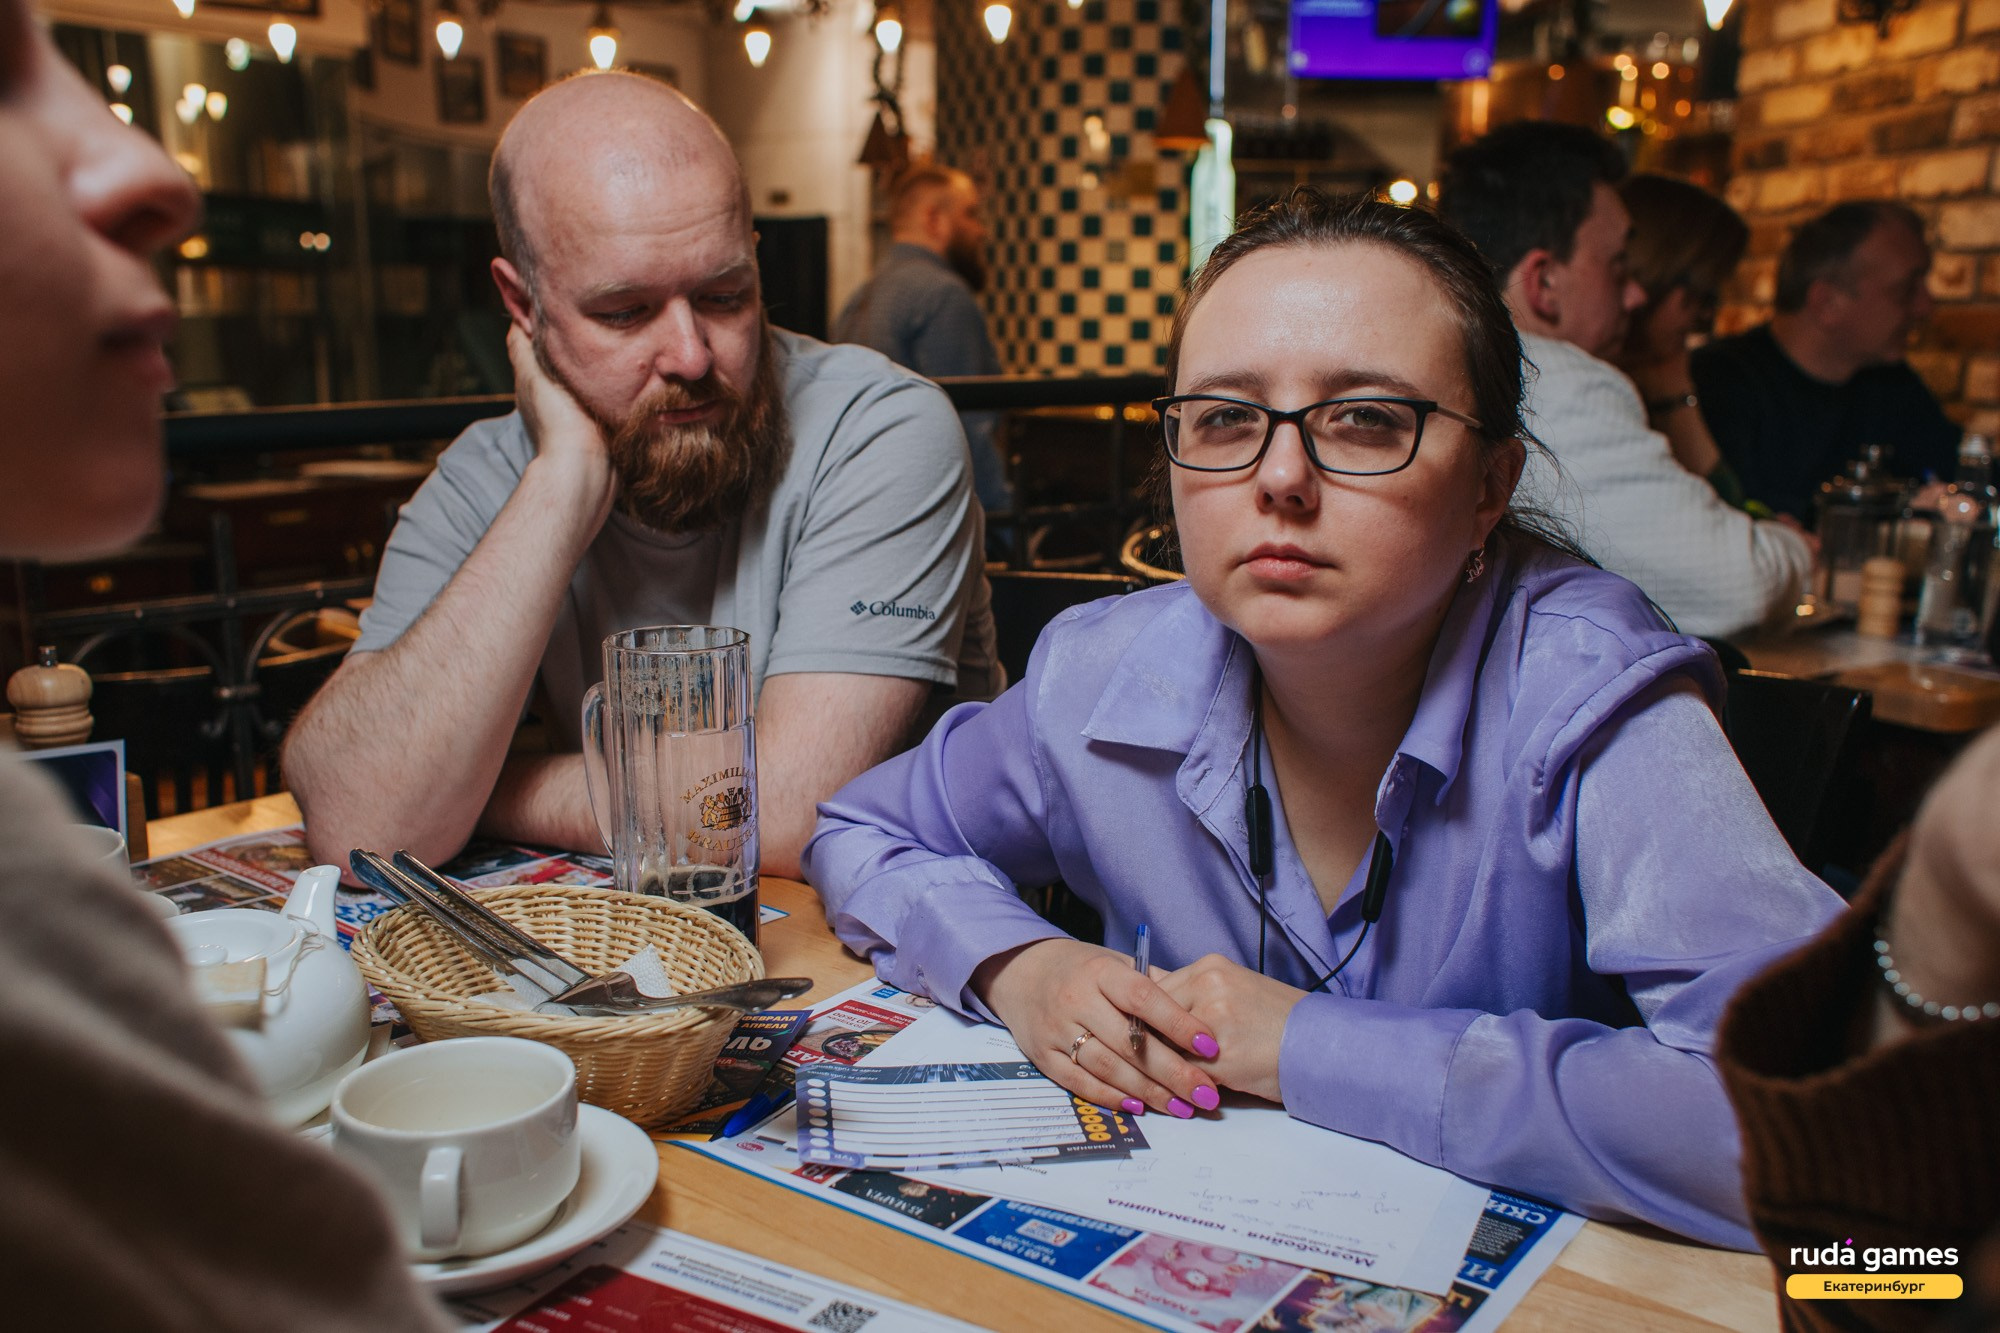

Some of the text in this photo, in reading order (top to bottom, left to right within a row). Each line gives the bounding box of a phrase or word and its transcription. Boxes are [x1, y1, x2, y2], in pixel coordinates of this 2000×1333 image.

[869, 600, 937, 620] Columbia
[723, 1036, 773, 1051] ЛЬ
[1247, 1231, 1377, 1268] Мозгобойня
